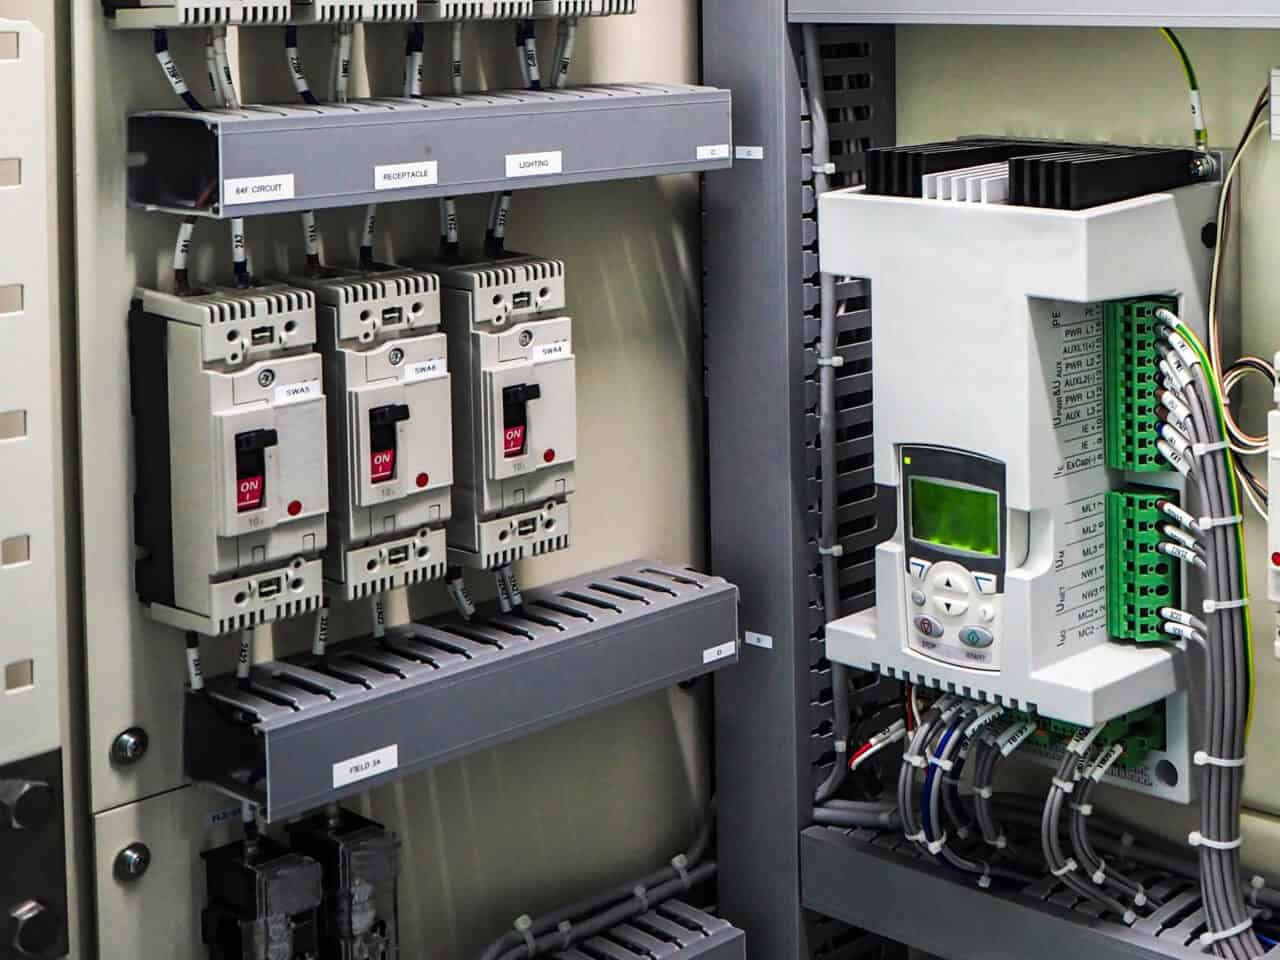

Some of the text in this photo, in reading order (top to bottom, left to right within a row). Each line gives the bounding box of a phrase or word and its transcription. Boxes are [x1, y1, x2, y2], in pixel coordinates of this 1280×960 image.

[519, 158, 549, 170] LIGHTING
[383, 168, 429, 181] RECEPTACLE
[251, 183, 283, 194] CIRCUIT
[1052, 311, 1061, 328] PE
[1064, 325, 1095, 338] PWR L1
[1065, 357, 1095, 371] PWR L2
[1065, 390, 1095, 405] PWR L3
[1065, 406, 1095, 421] AUX L3
[505, 428, 522, 440] ON
[373, 453, 391, 465] ON
[240, 479, 260, 492] ON
[1081, 502, 1097, 514] ML1
[1082, 523, 1097, 536] ML2
[1082, 545, 1098, 558] ML3
[1081, 567, 1098, 579] NW1
[350, 761, 371, 776] FIELD
